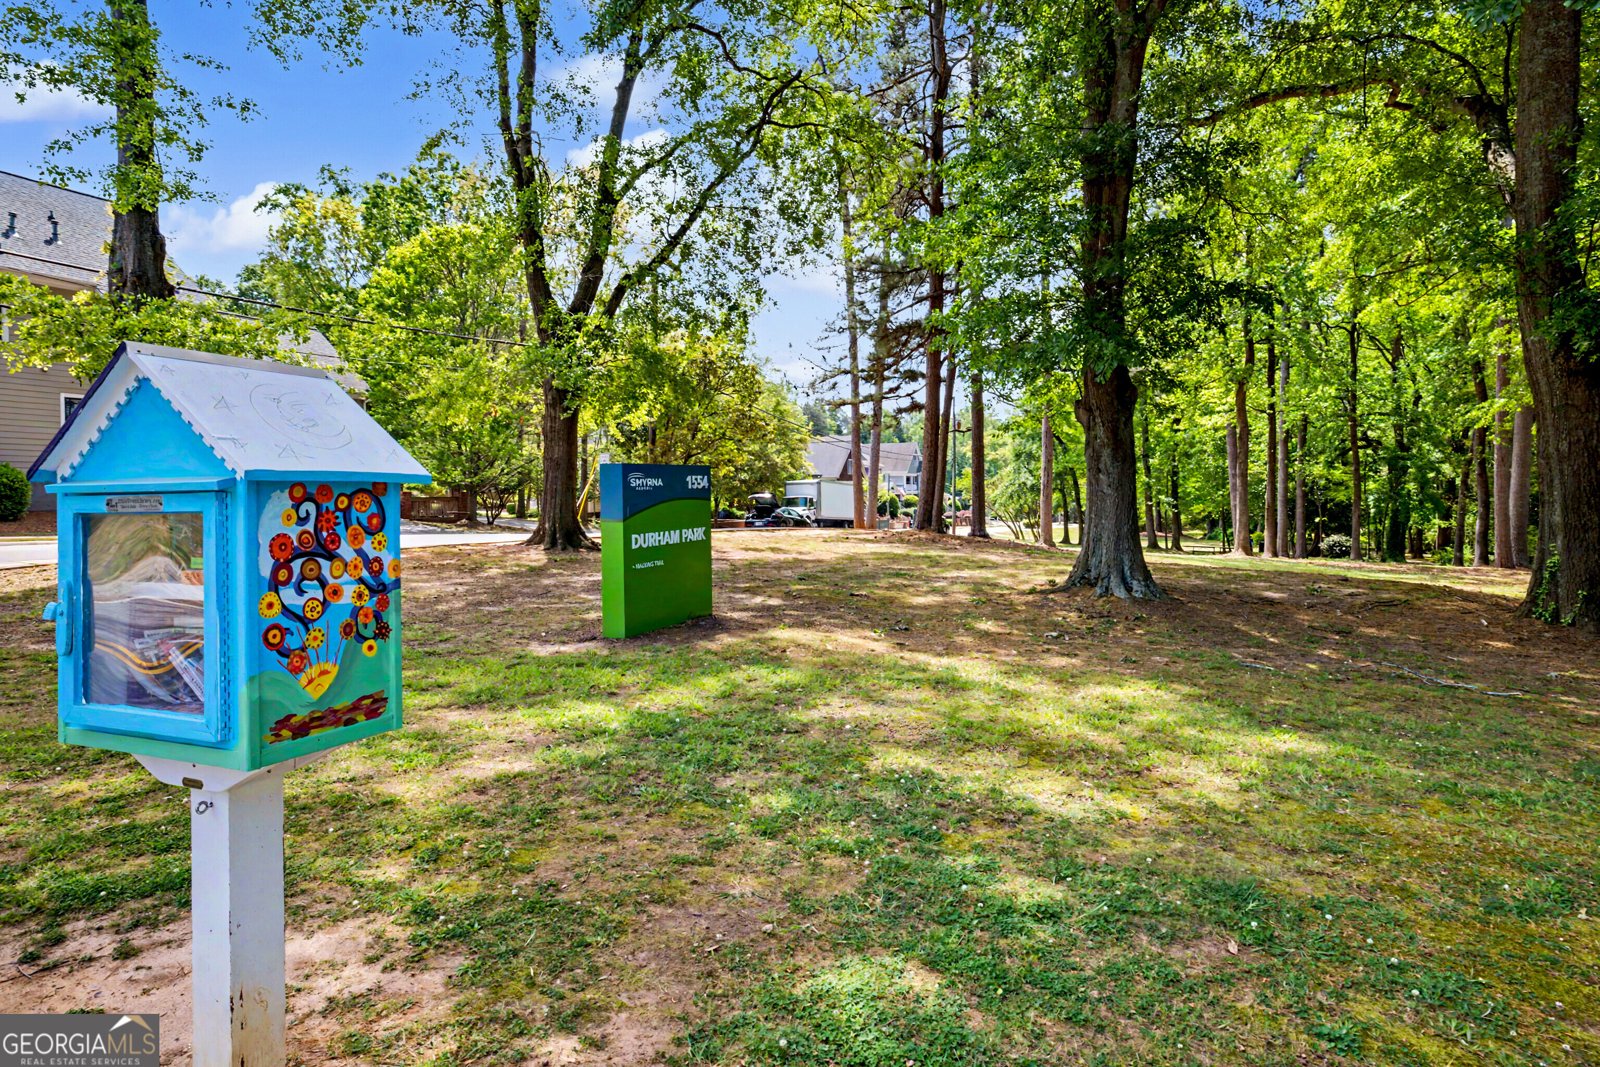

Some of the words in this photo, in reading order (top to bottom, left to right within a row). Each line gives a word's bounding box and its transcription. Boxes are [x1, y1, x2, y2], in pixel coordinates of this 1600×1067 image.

[630, 478, 663, 486] SMYRNA
[686, 475, 709, 489] 1554
[631, 530, 680, 550] DURHAM
[682, 527, 706, 542] PARK
